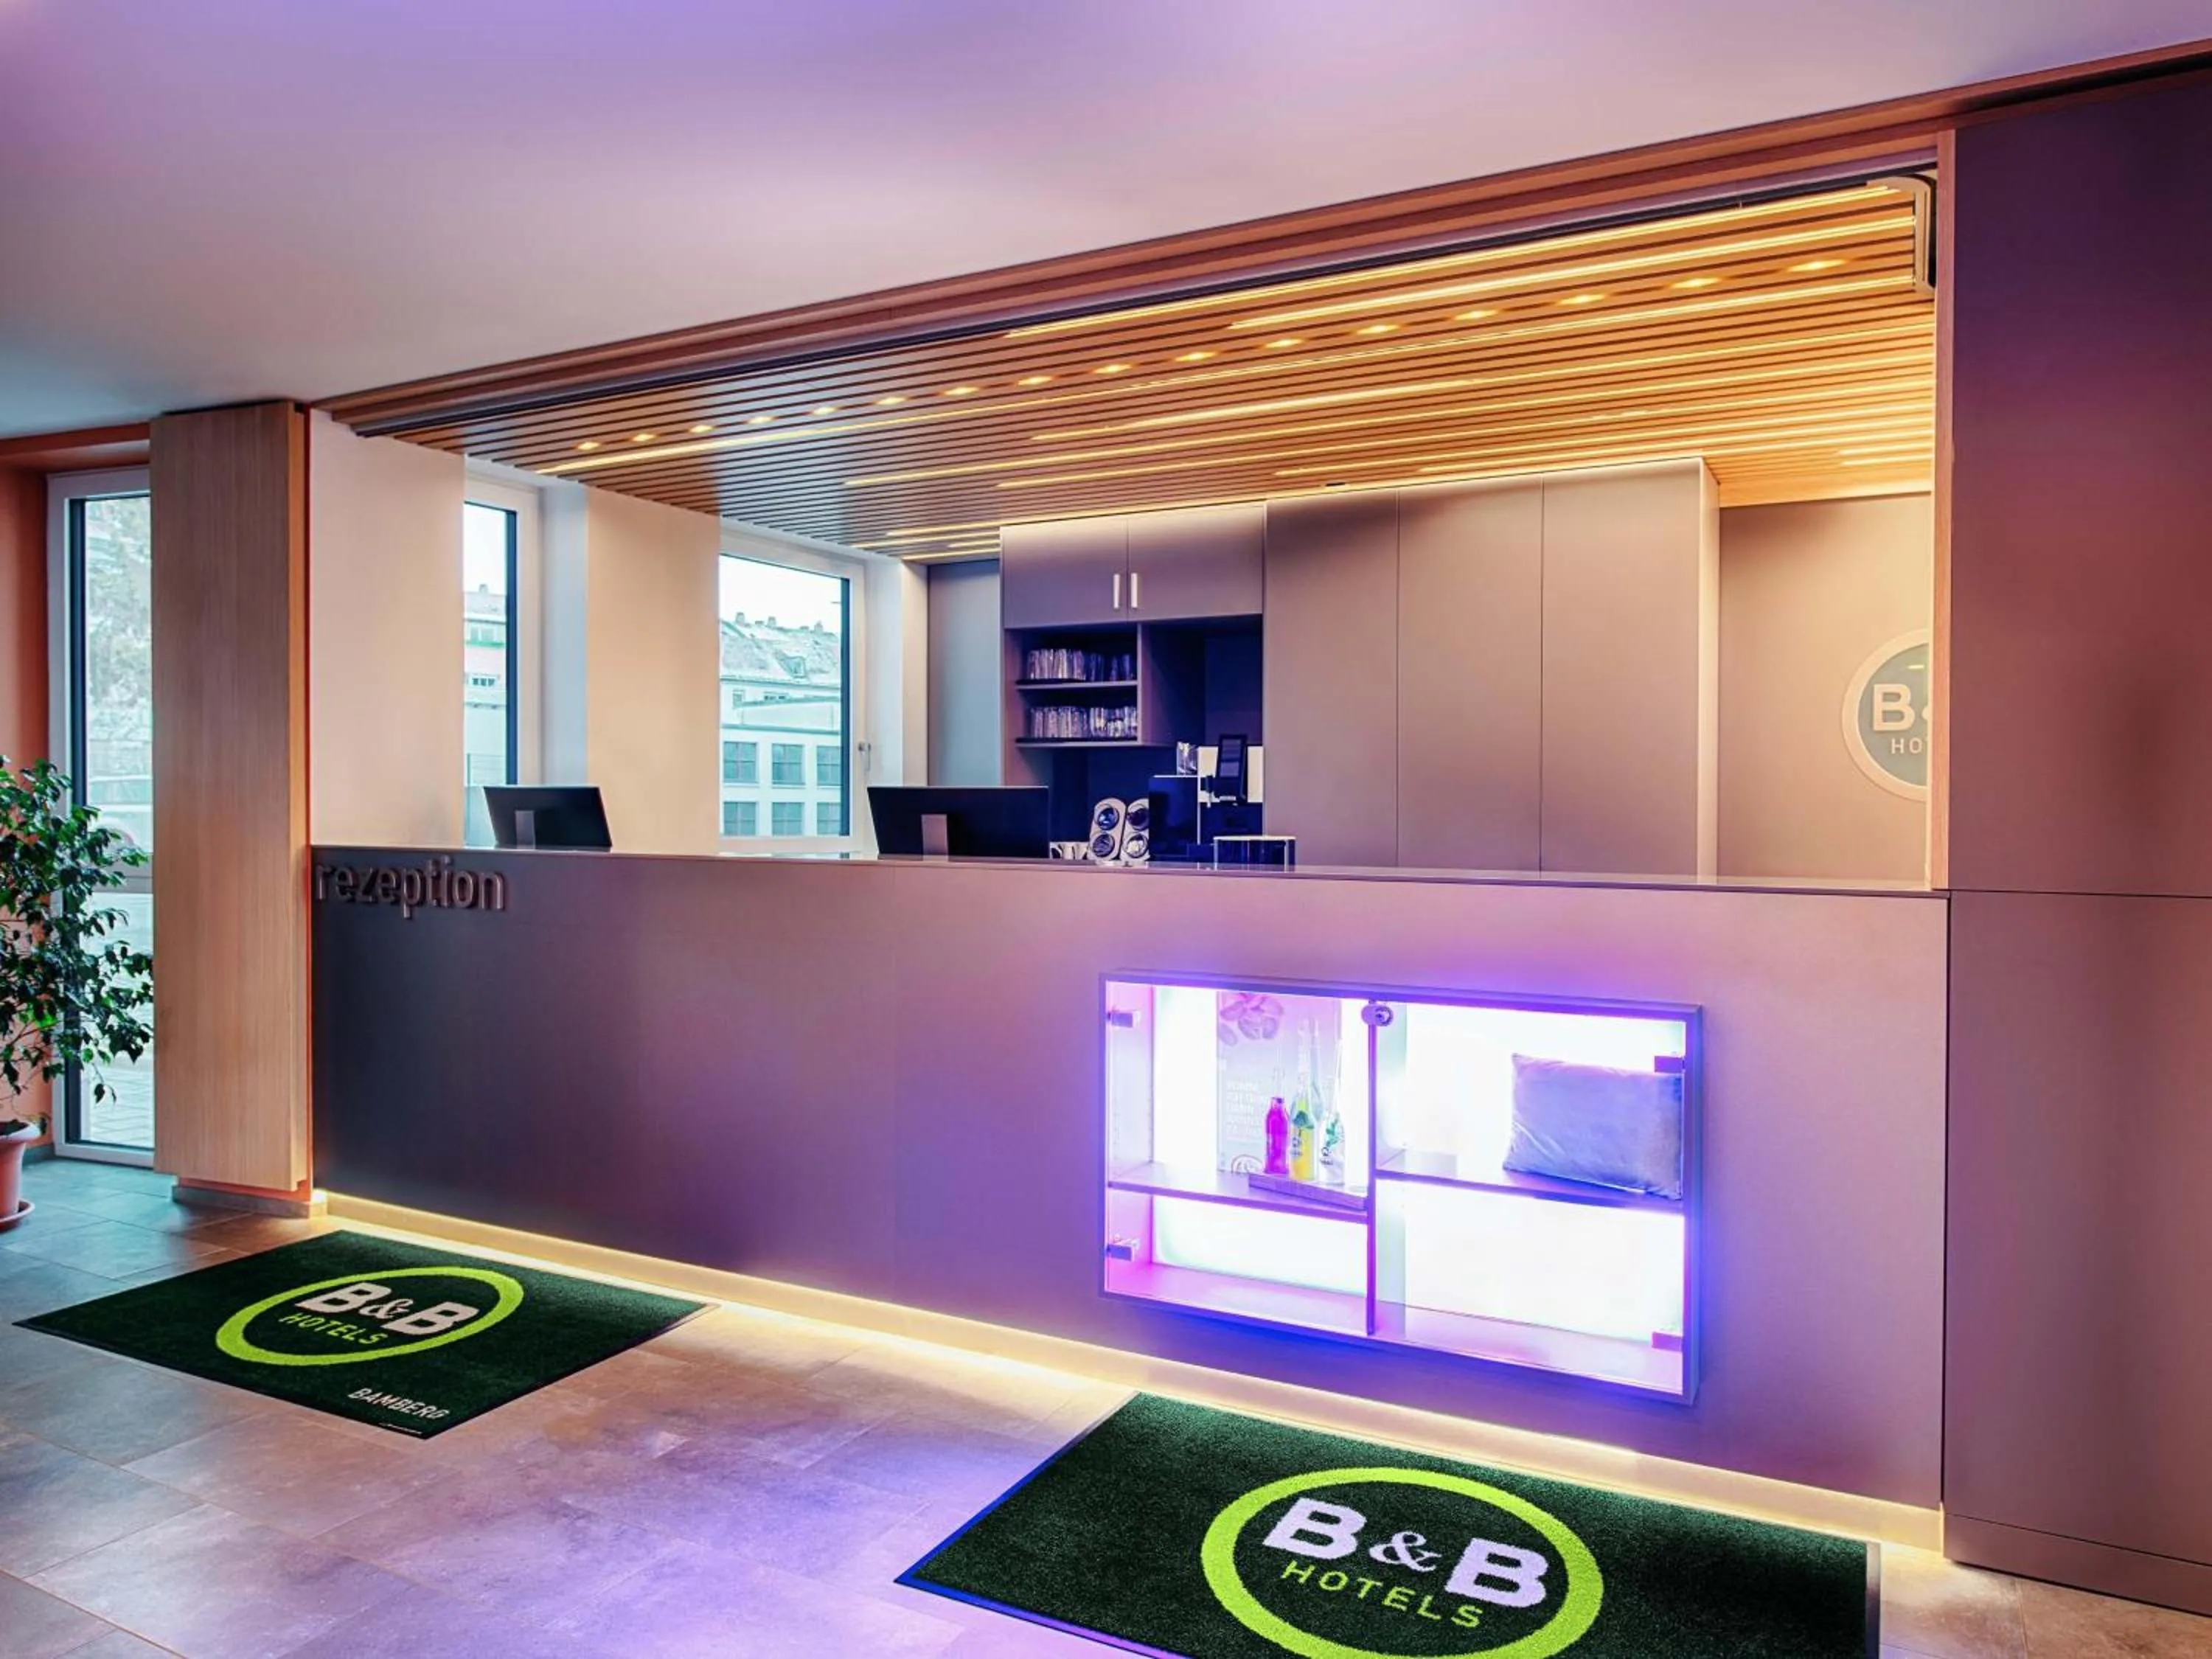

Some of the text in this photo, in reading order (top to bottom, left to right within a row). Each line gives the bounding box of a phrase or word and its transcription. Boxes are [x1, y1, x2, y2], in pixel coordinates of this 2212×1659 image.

[1873, 683, 1929, 731] B
[316, 855, 506, 919] rezeption
[278, 1312, 389, 1345] HOTELS
[295, 1281, 479, 1336] B&B
[347, 1387, 451, 1420] BAMBERG
[1262, 1497, 1549, 1608] B&B
[1280, 1560, 1484, 1628] HOTELS
